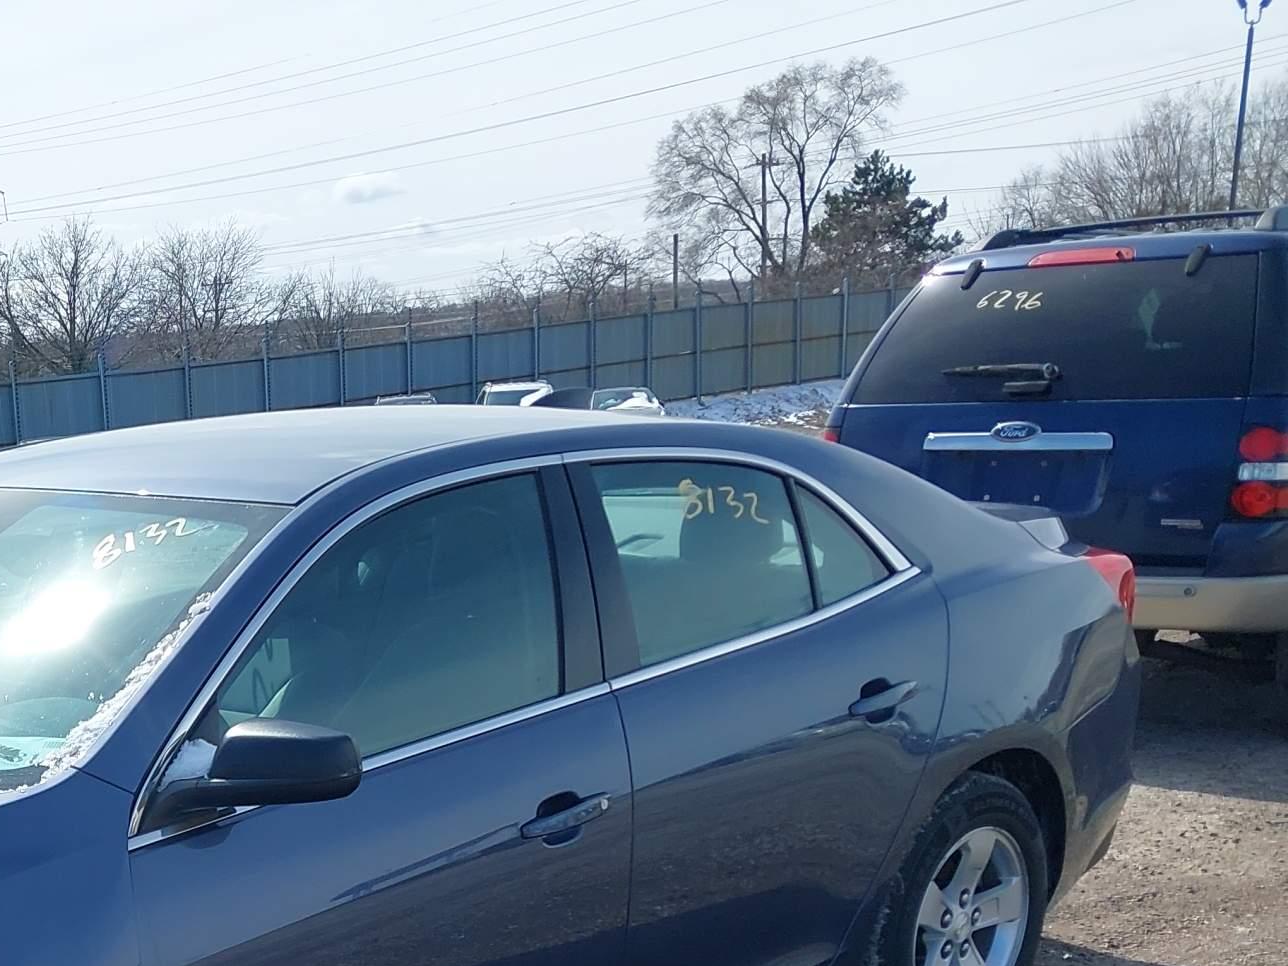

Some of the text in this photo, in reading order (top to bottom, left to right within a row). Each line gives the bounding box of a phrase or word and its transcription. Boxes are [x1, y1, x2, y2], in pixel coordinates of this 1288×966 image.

[976, 289, 1044, 311] 6296
[999, 424, 1029, 437] Ford
[678, 477, 771, 524] 8132
[91, 516, 220, 570] 8132
